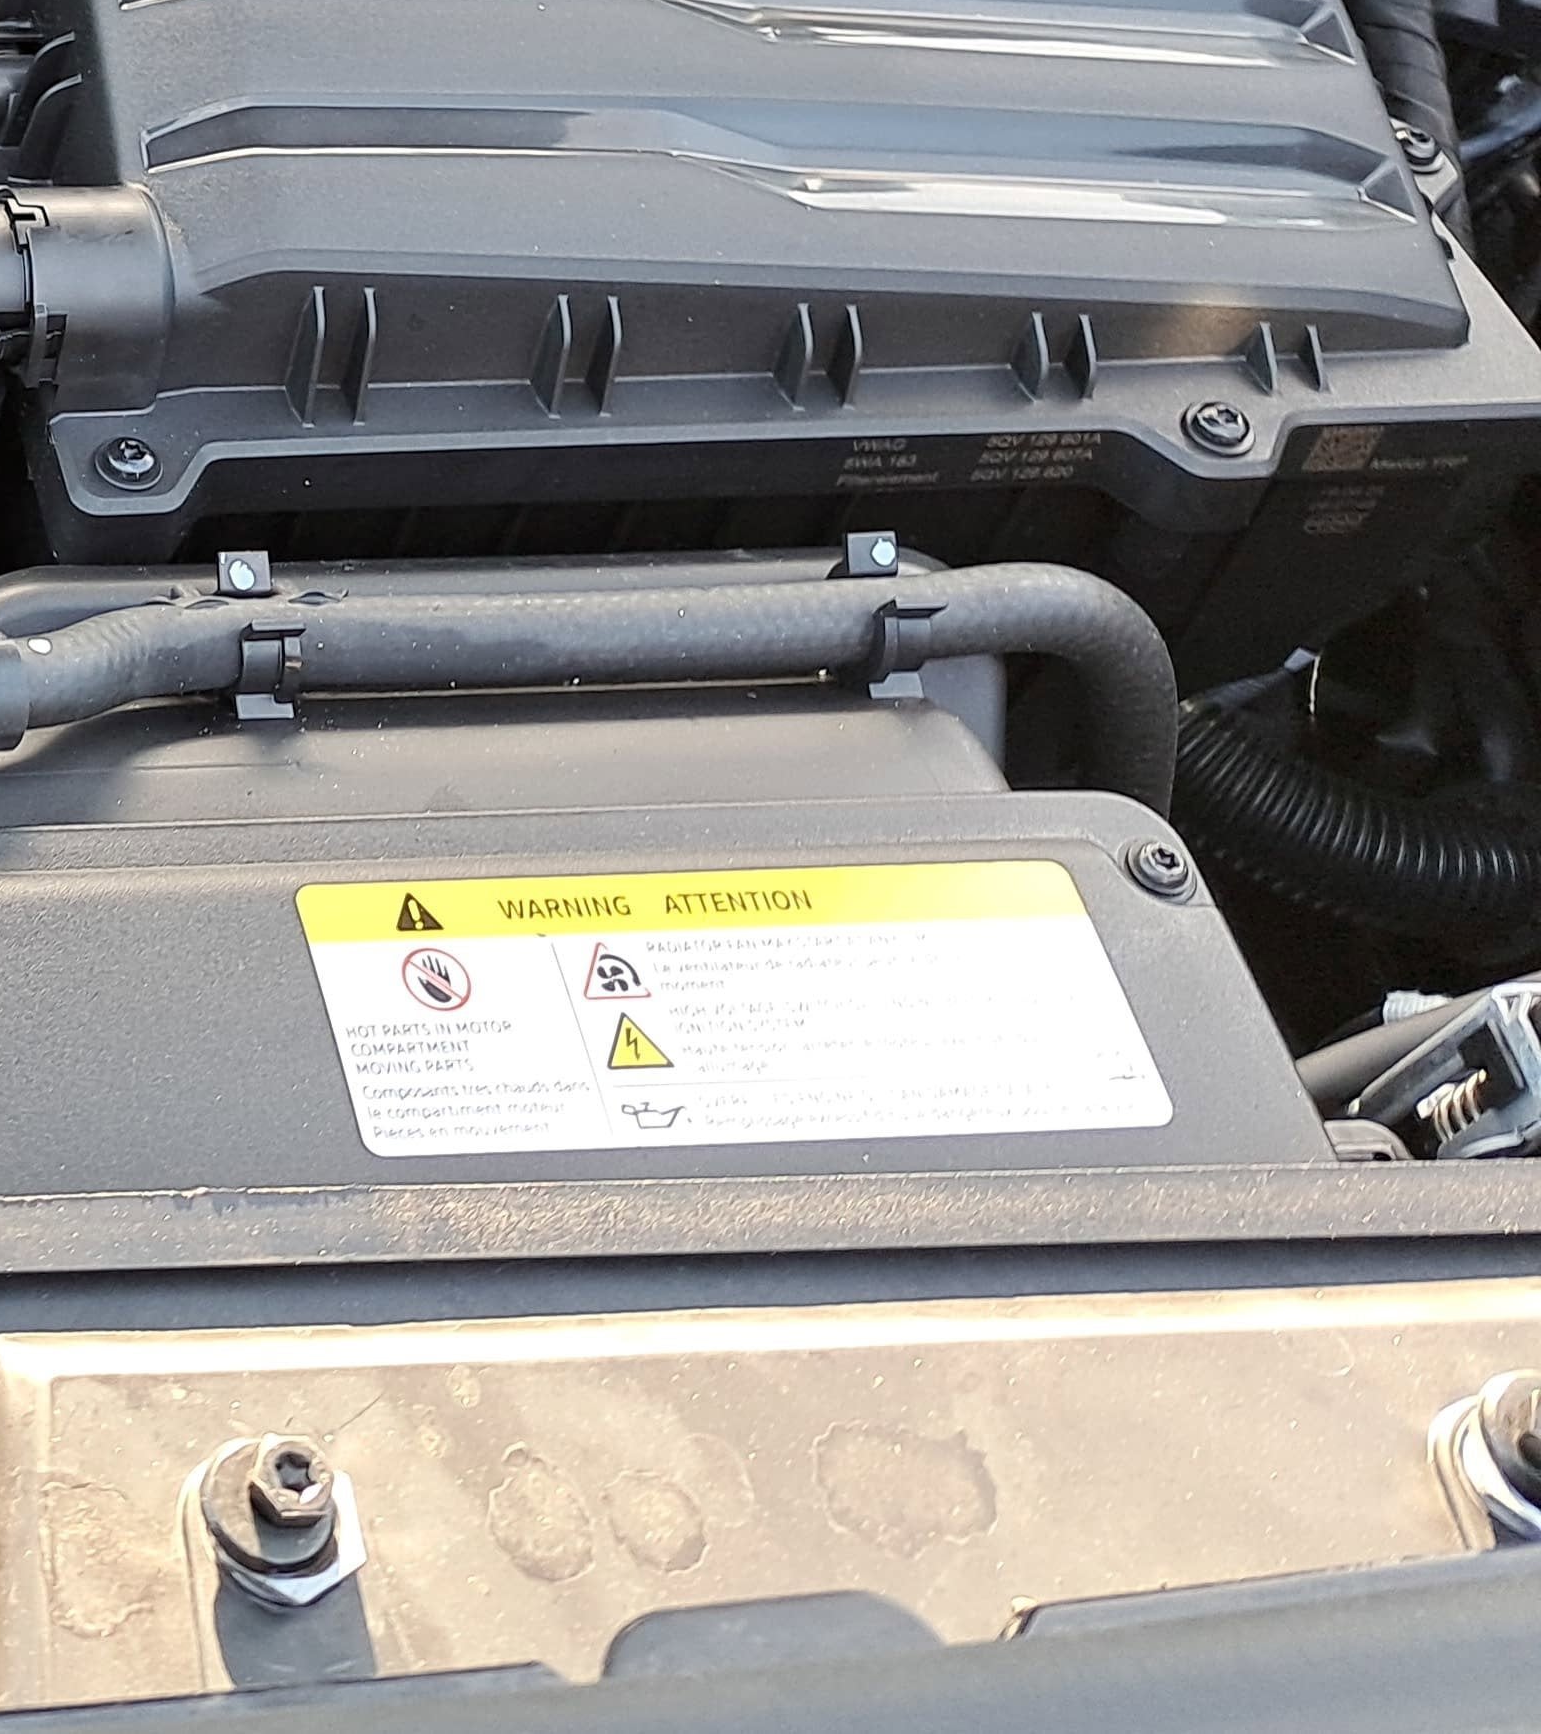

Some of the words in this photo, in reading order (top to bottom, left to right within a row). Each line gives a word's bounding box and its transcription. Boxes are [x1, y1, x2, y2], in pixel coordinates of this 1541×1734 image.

[497, 894, 632, 922] WARNING
[663, 890, 813, 916] ATTENTION
[346, 1025, 377, 1039] HOT
[382, 1023, 431, 1038] PARTS
[435, 1023, 451, 1035] IN
[456, 1020, 512, 1034] MOTOR
[351, 1040, 470, 1057] COMPARTMENT
[356, 1059, 421, 1075] MOVING
[425, 1058, 474, 1072] PARTS
